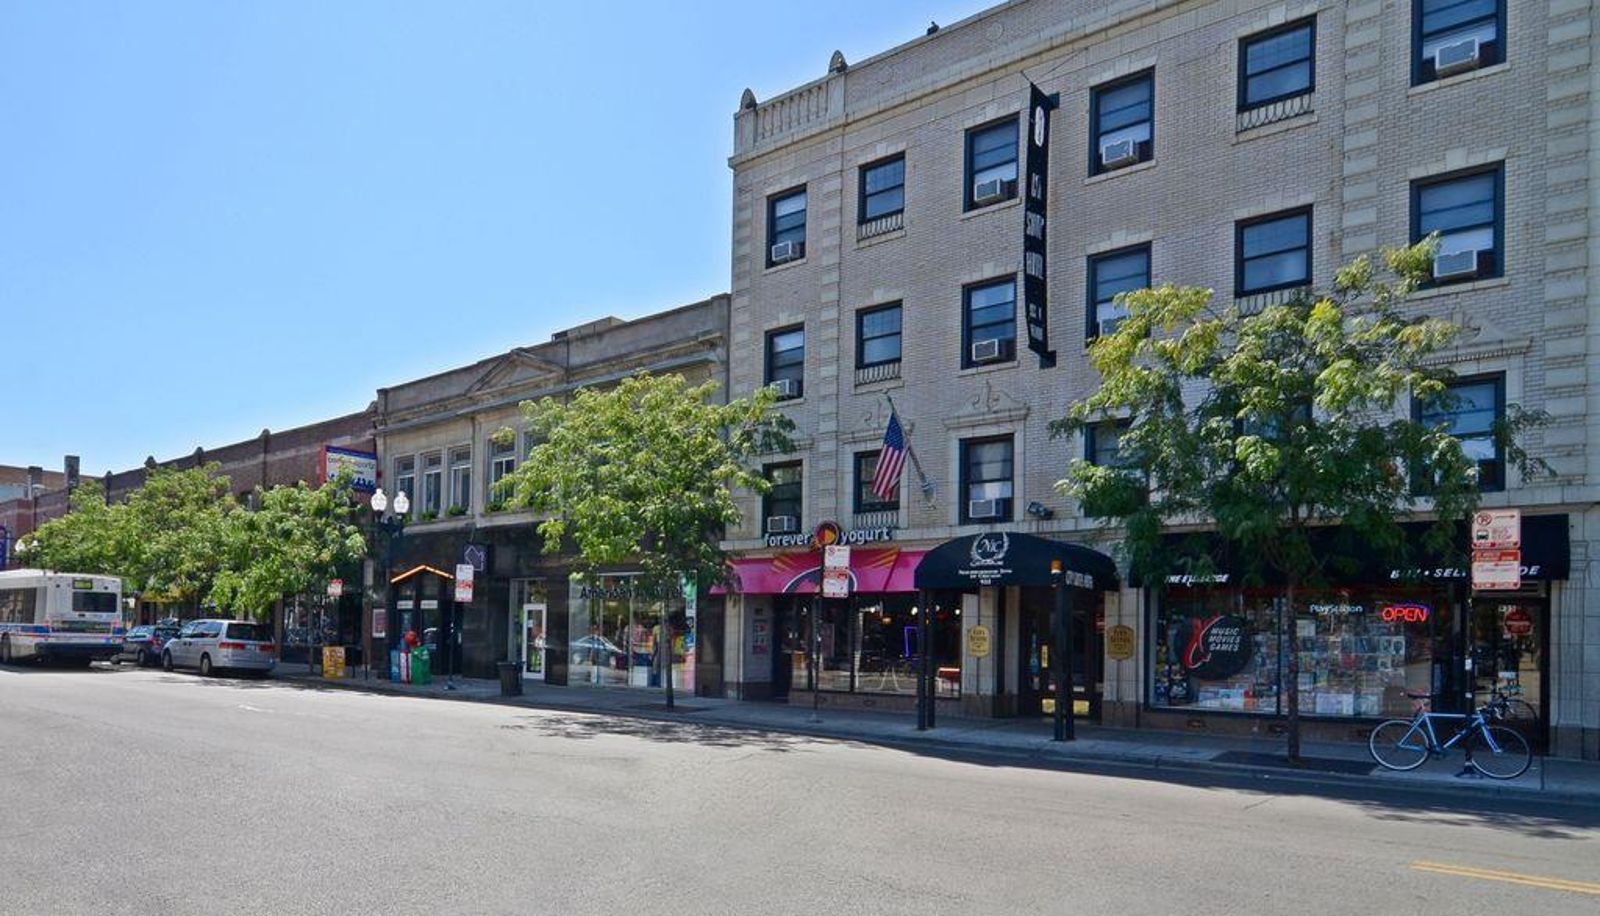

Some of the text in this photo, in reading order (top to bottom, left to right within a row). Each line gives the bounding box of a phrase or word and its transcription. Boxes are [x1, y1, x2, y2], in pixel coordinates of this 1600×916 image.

[763, 527, 891, 547] forever yogurt
[1433, 567, 1467, 578] SEL
[1382, 607, 1428, 622] OPEN
[1210, 627, 1240, 636] MUSIC
[1208, 635, 1241, 644] MOVIES
[1209, 643, 1240, 652] GAMES
